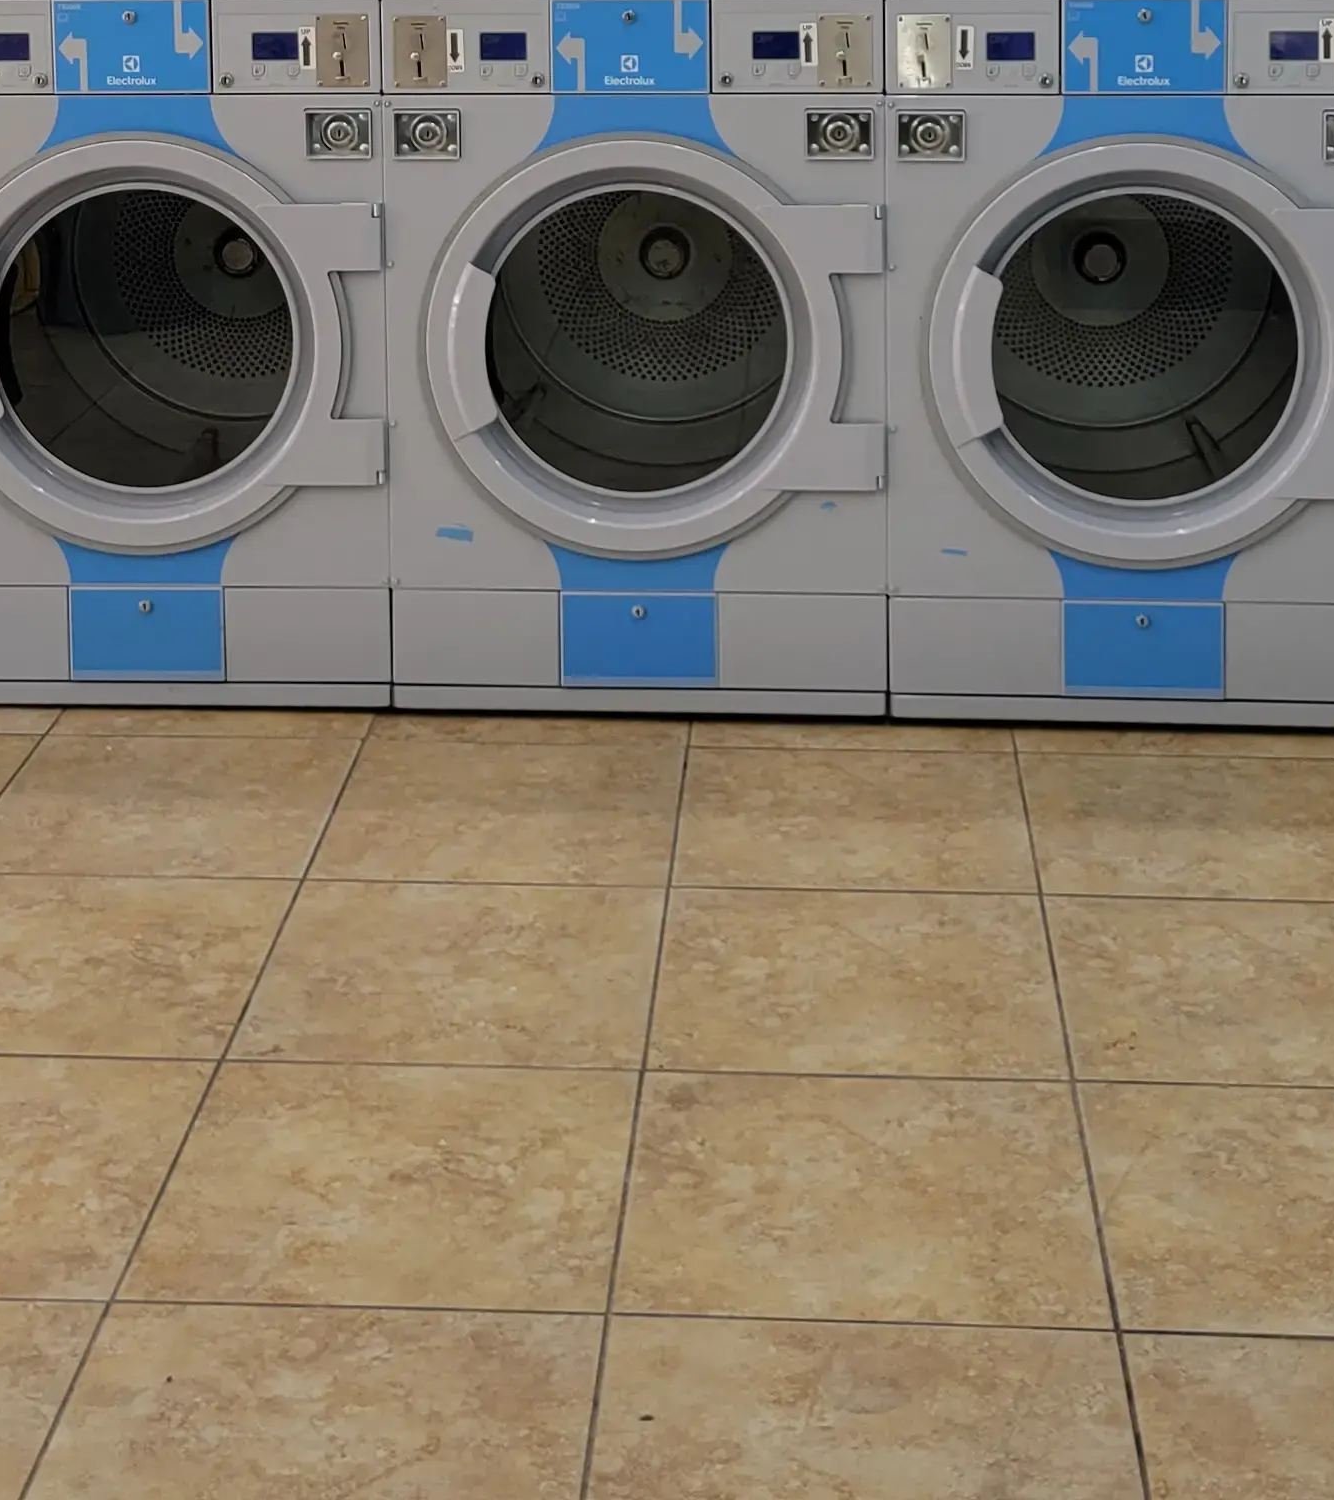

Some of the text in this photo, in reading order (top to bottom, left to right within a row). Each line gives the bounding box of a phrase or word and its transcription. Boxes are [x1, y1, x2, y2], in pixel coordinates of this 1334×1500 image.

[1321, 19, 1333, 27] UP
[107, 75, 157, 86] Electrolux
[604, 75, 655, 86] Electrolux
[1117, 75, 1170, 86] Electrolux
